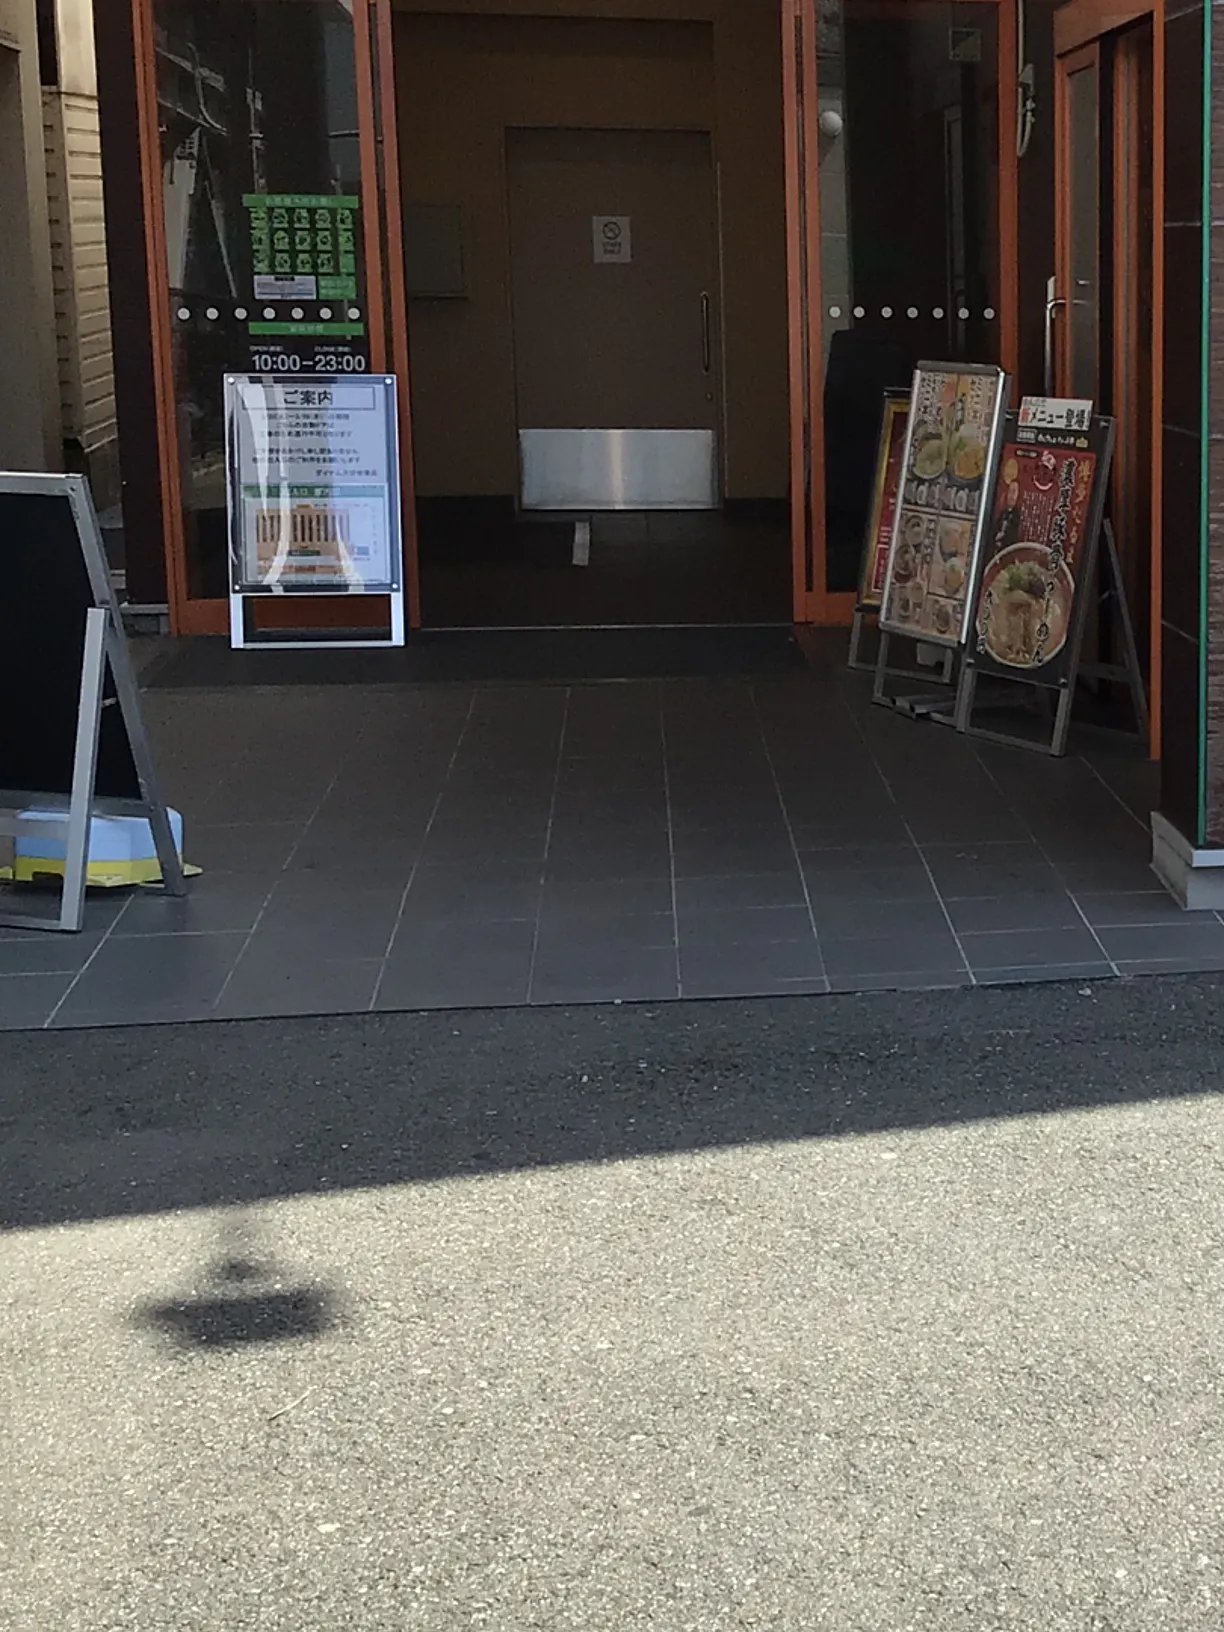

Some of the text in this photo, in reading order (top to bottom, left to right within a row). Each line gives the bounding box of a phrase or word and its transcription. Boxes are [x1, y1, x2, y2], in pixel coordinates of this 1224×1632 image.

[251, 354, 366, 371] 10:00-23:00
[283, 389, 333, 405] ご案内
